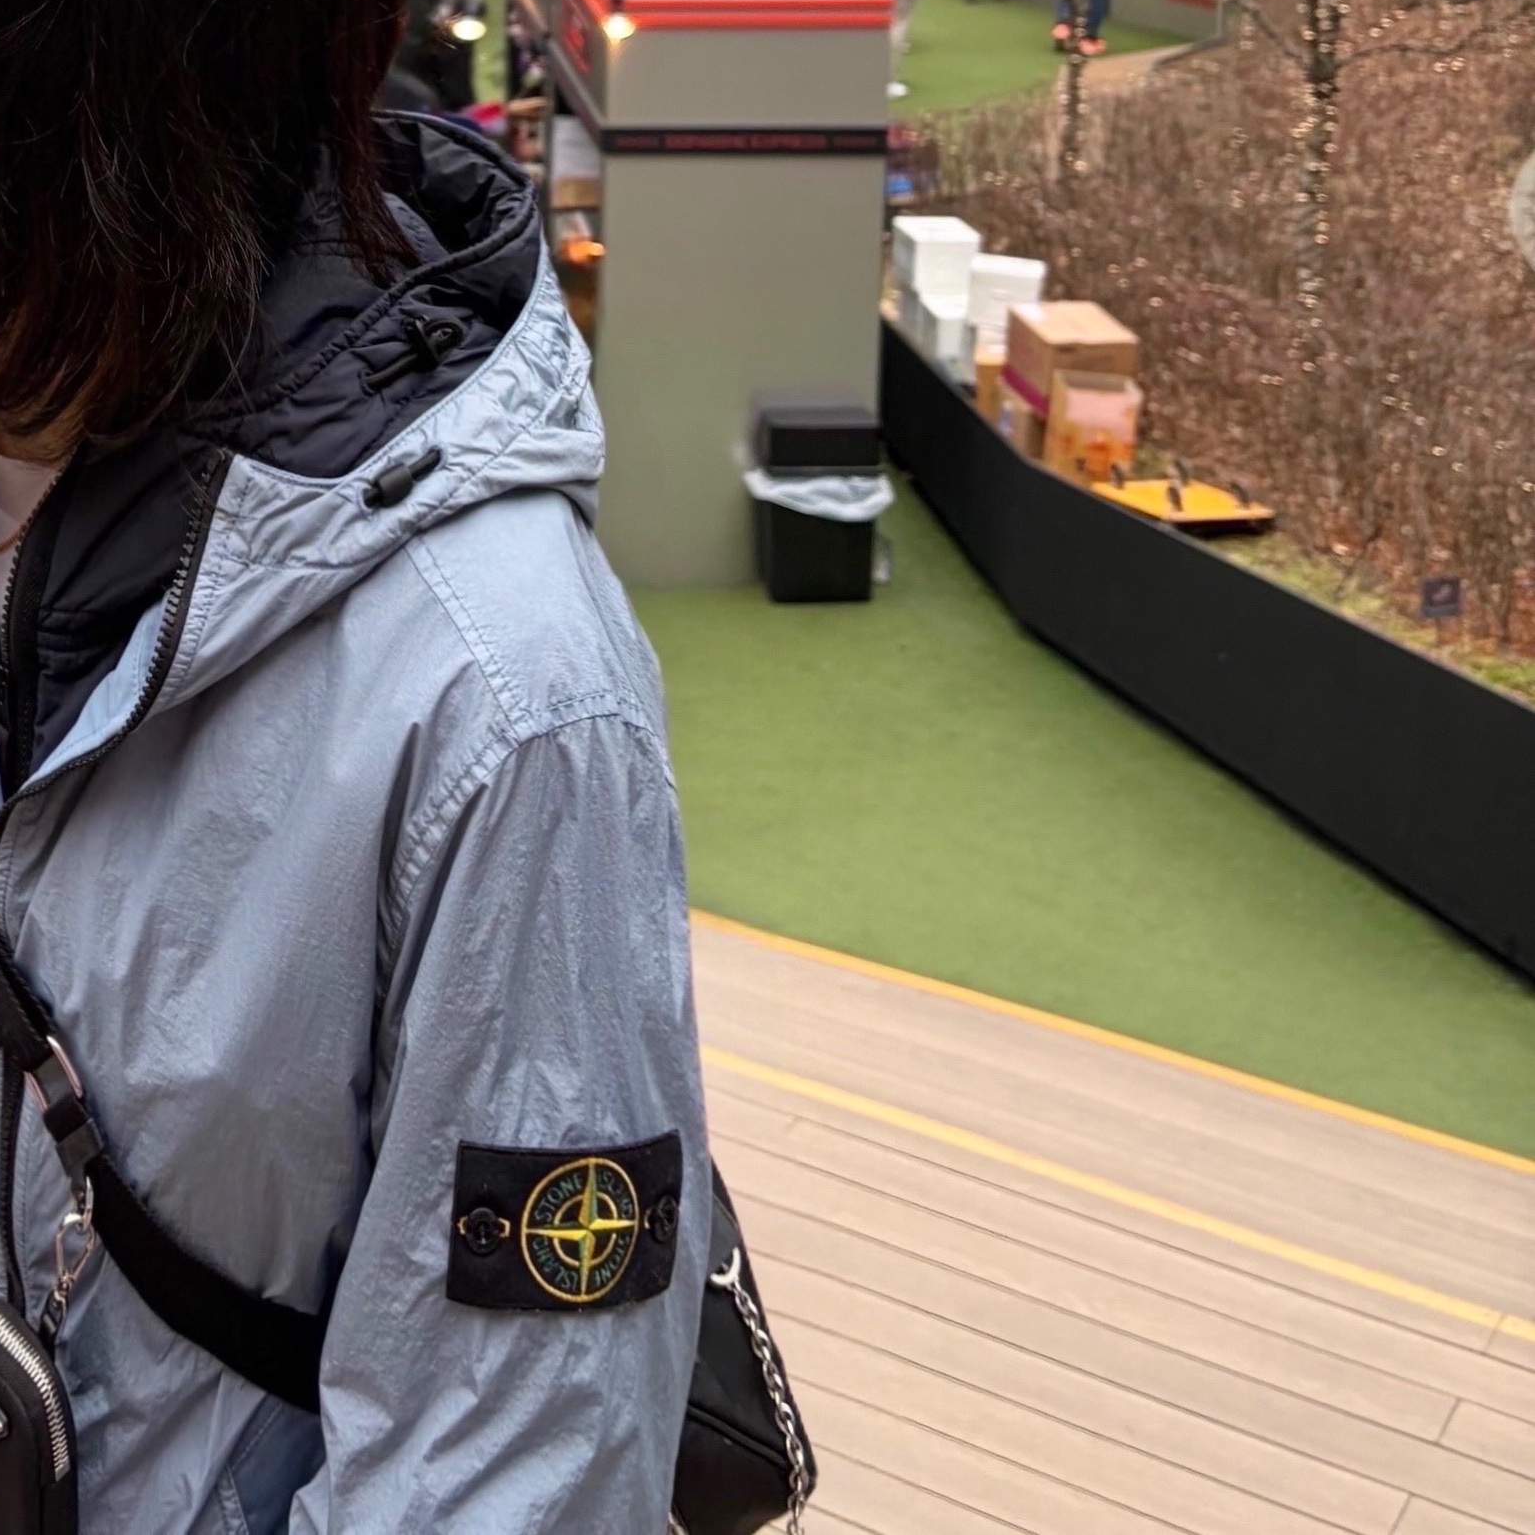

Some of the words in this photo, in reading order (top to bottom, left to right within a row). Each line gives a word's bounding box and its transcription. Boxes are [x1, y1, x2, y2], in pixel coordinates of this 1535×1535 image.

[533, 1172, 583, 1223] STONE
[531, 1236, 579, 1292] ISLAND
[594, 1234, 631, 1288] STONE
